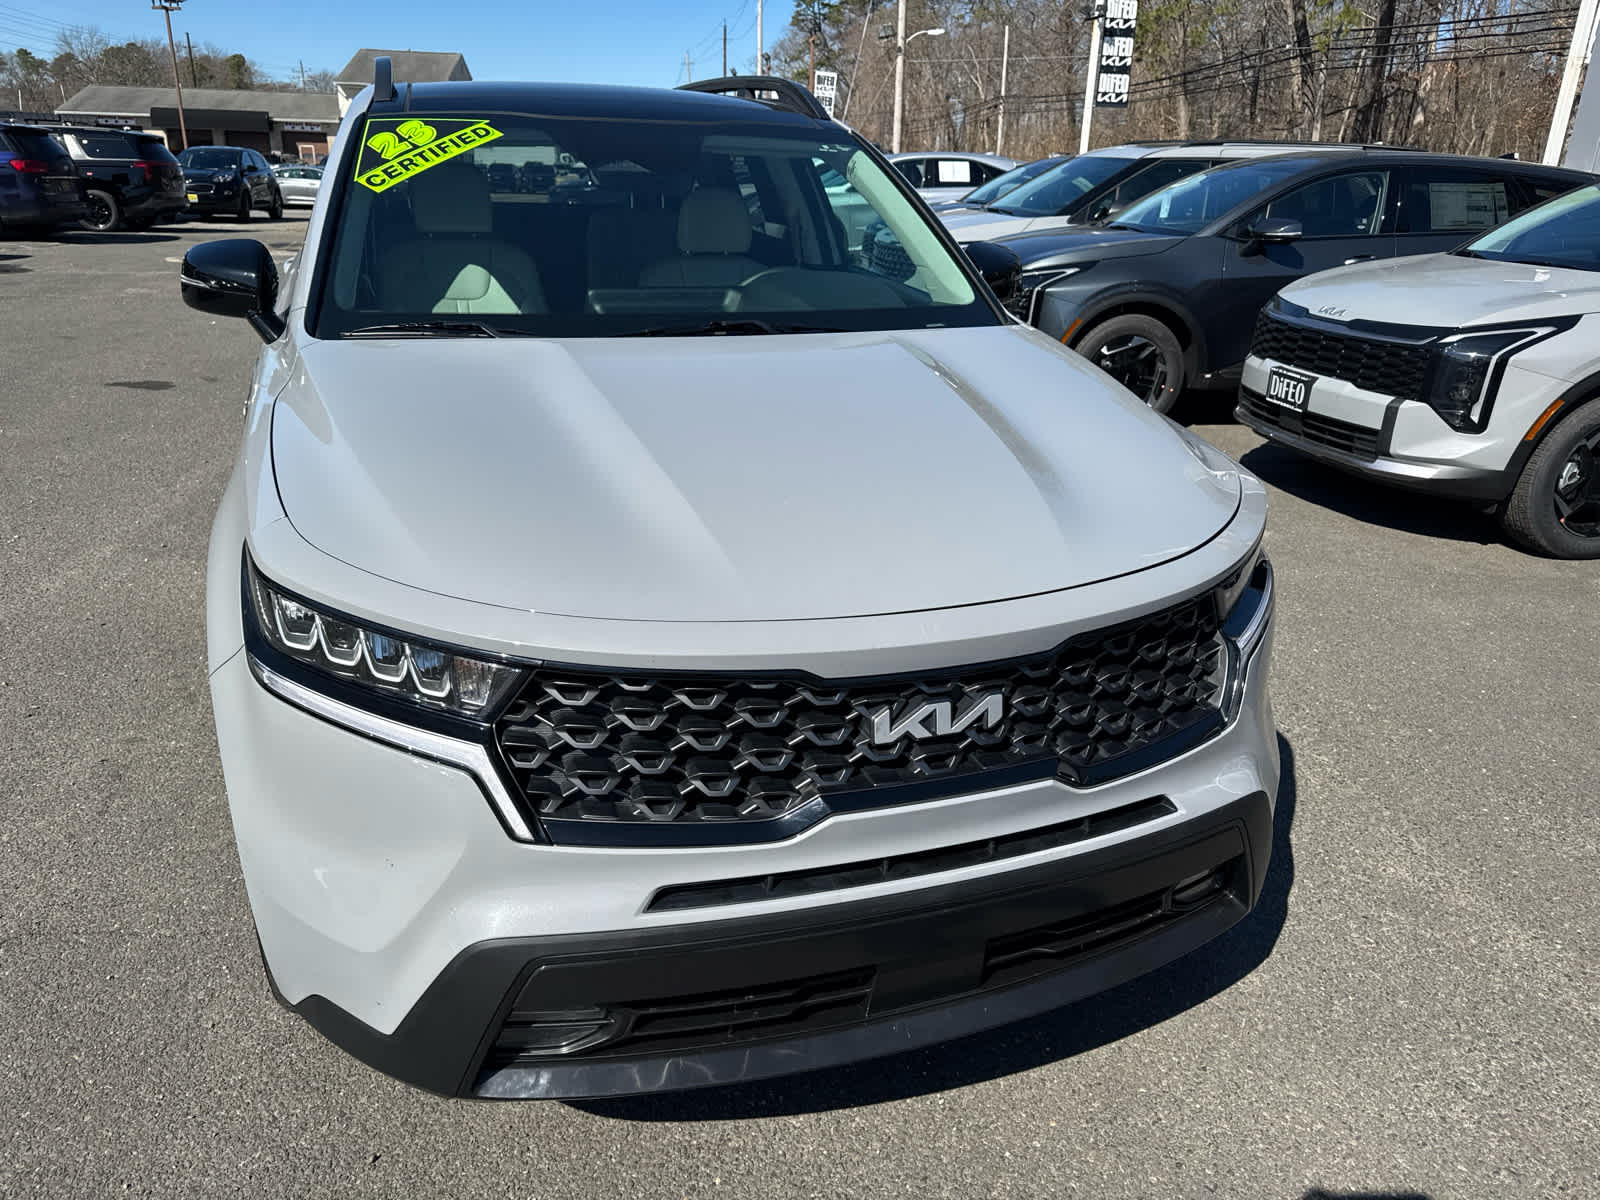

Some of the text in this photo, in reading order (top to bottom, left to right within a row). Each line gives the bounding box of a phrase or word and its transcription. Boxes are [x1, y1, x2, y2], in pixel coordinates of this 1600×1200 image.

[1105, 19, 1136, 29] KIA
[1101, 56, 1132, 67] KIA
[1097, 92, 1128, 103] KIA
[367, 120, 437, 160] 23
[365, 126, 491, 187] CERTIFIED
[873, 694, 1003, 745] KIA
